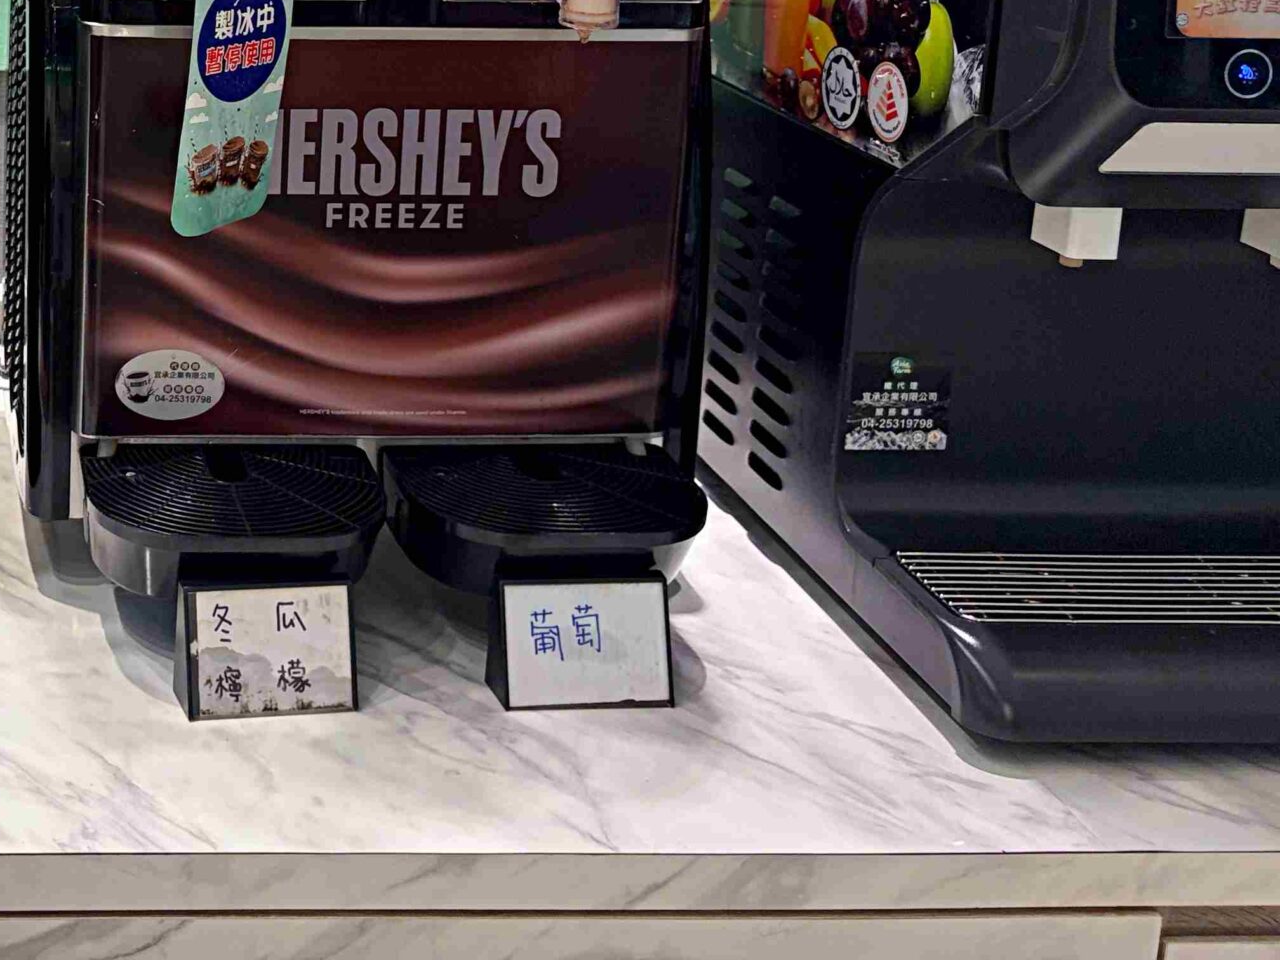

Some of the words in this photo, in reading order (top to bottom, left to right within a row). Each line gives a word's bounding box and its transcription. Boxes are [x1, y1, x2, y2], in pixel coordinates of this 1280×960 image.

[214, 2, 275, 40] 製冰中
[205, 36, 277, 76] 暫停使用
[325, 202, 465, 229] FREEZE
[154, 394, 212, 404] 04-25319798
[861, 418, 933, 429] 04-25319798
[530, 604, 602, 661] 葡萄
[214, 658, 312, 703] 檸檬
